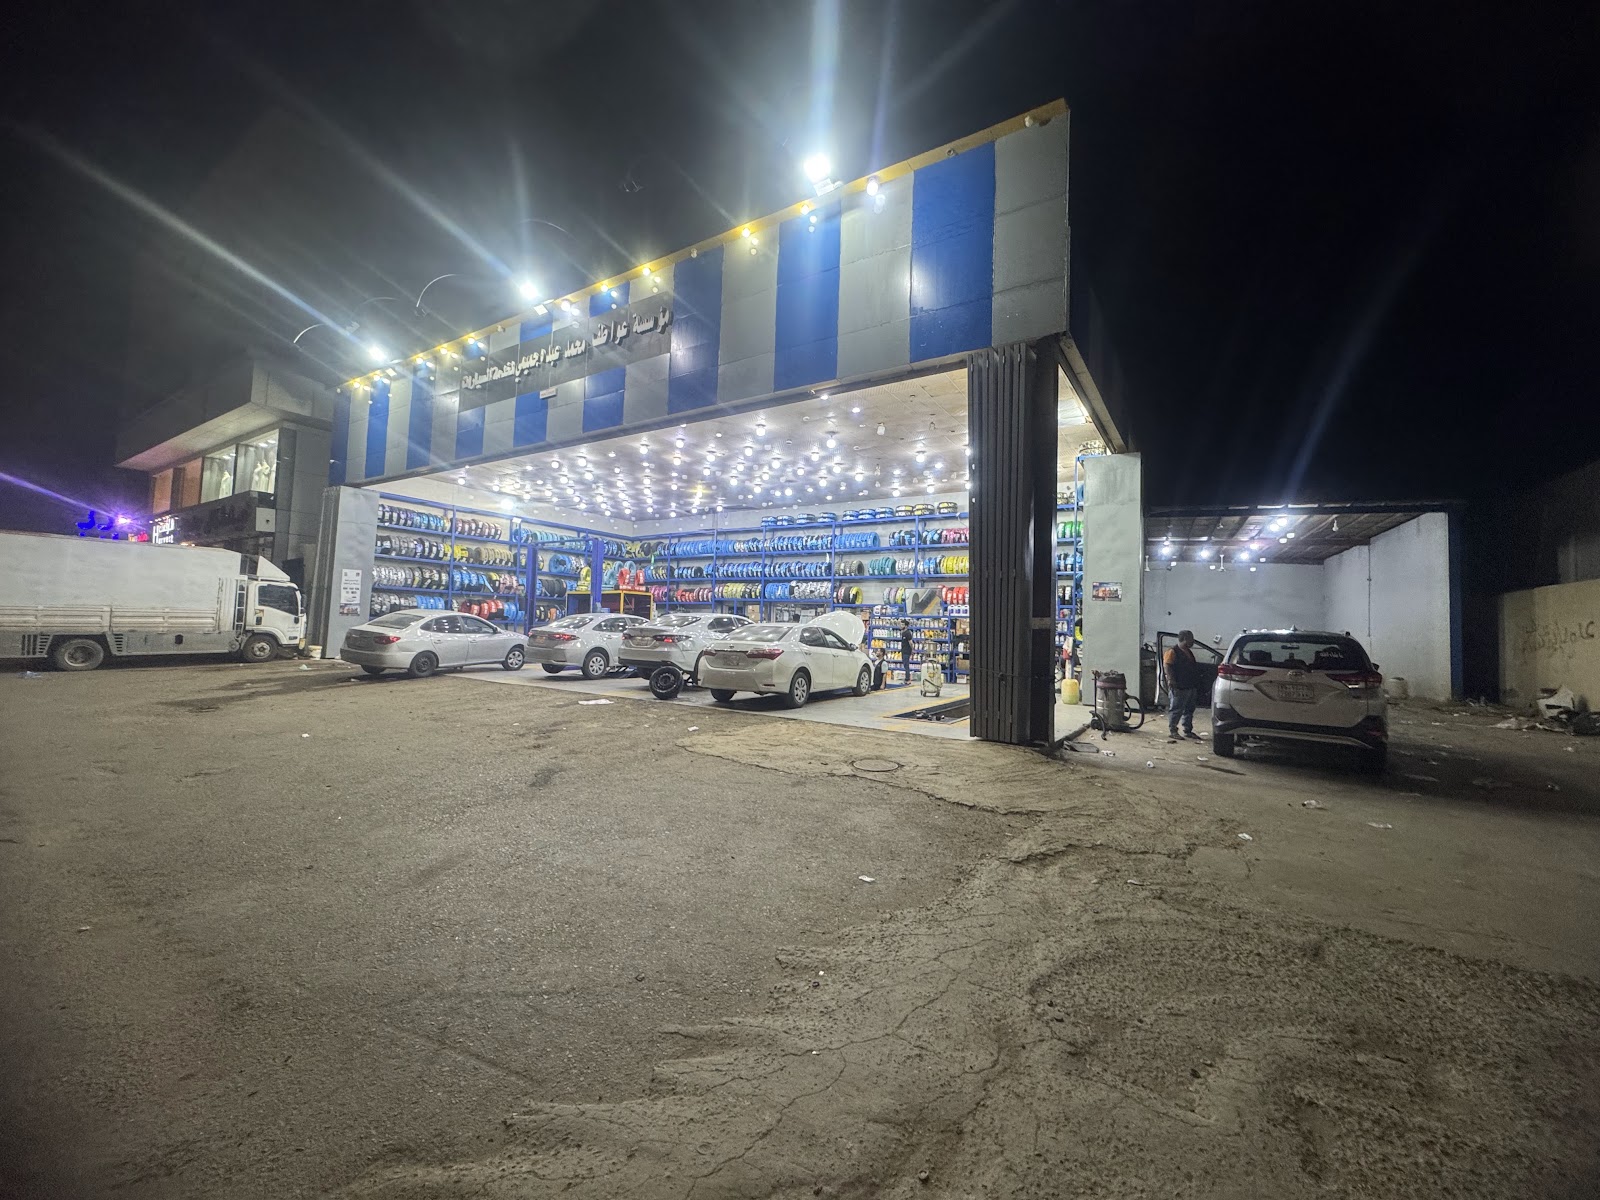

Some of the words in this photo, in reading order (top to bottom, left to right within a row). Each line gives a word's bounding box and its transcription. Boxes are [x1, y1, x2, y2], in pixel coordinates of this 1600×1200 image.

[632, 306, 669, 334] مؤسسة
[564, 339, 586, 358] محمد
[461, 367, 491, 390] السيارات
